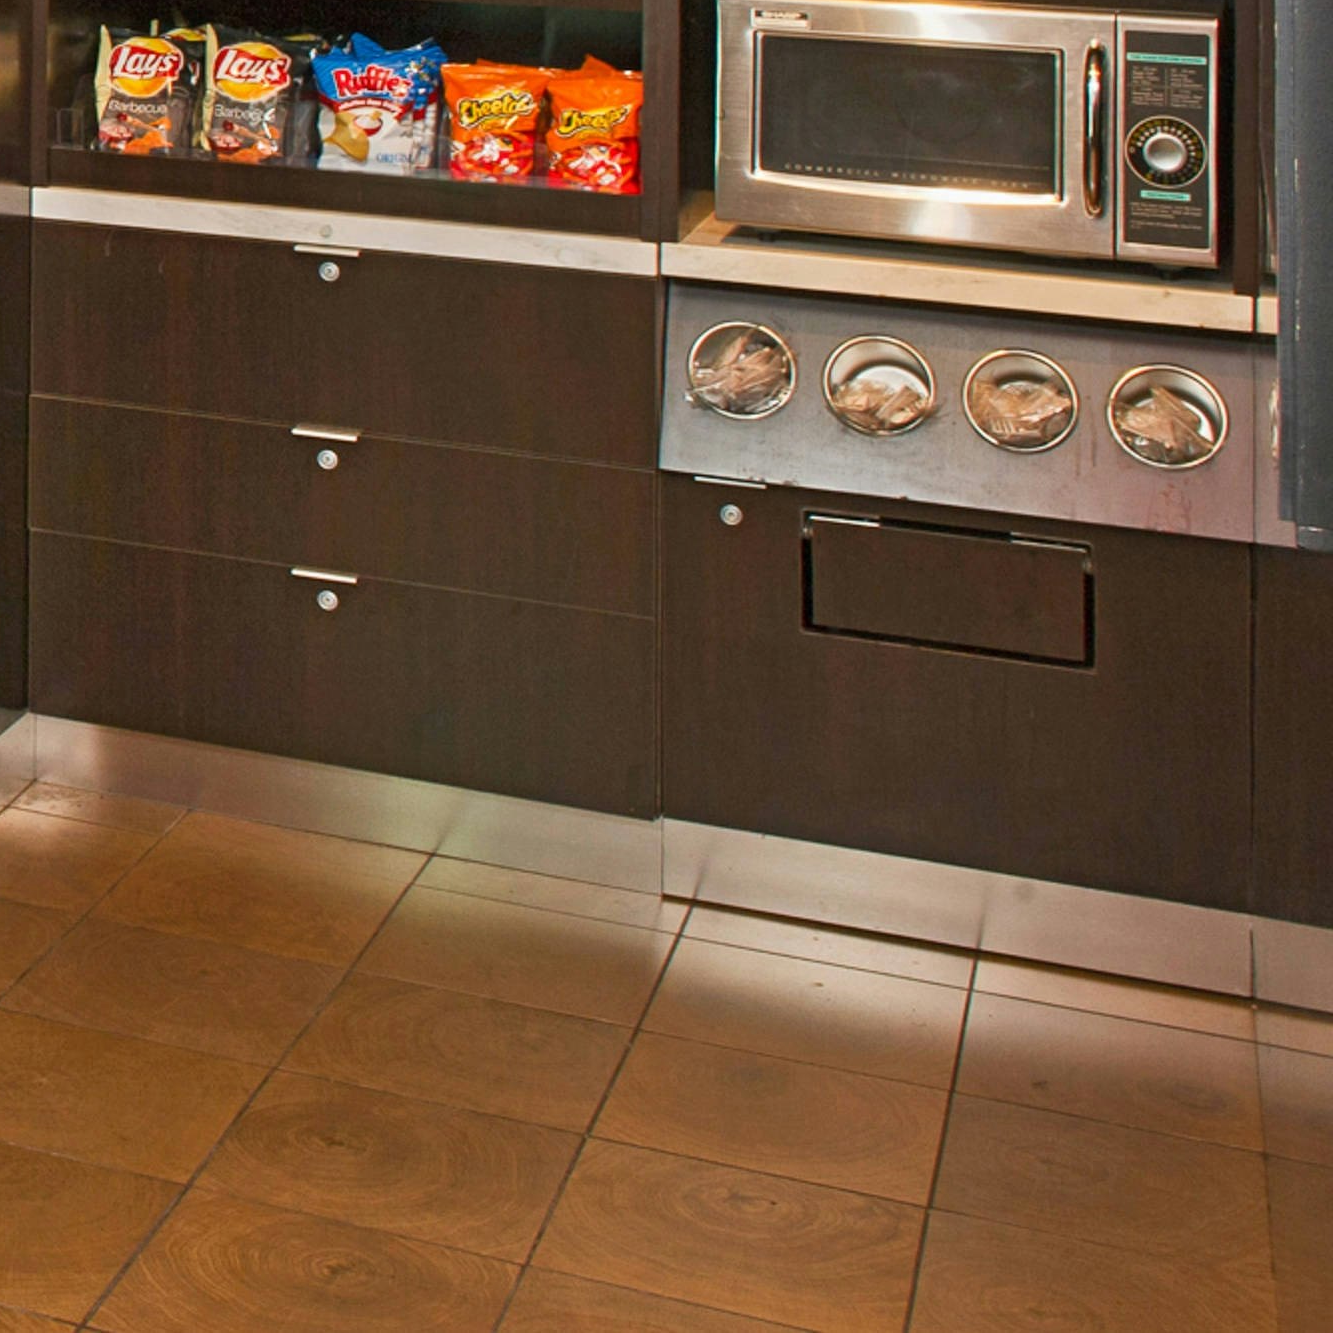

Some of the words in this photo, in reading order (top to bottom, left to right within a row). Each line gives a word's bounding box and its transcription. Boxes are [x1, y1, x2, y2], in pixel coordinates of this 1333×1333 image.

[113, 47, 179, 79] Lay's
[215, 48, 281, 81] Lay's
[109, 100, 168, 114] Barbecue
[784, 162, 880, 177] COMMERCIAL
[890, 171, 979, 184] MICROWAVE
